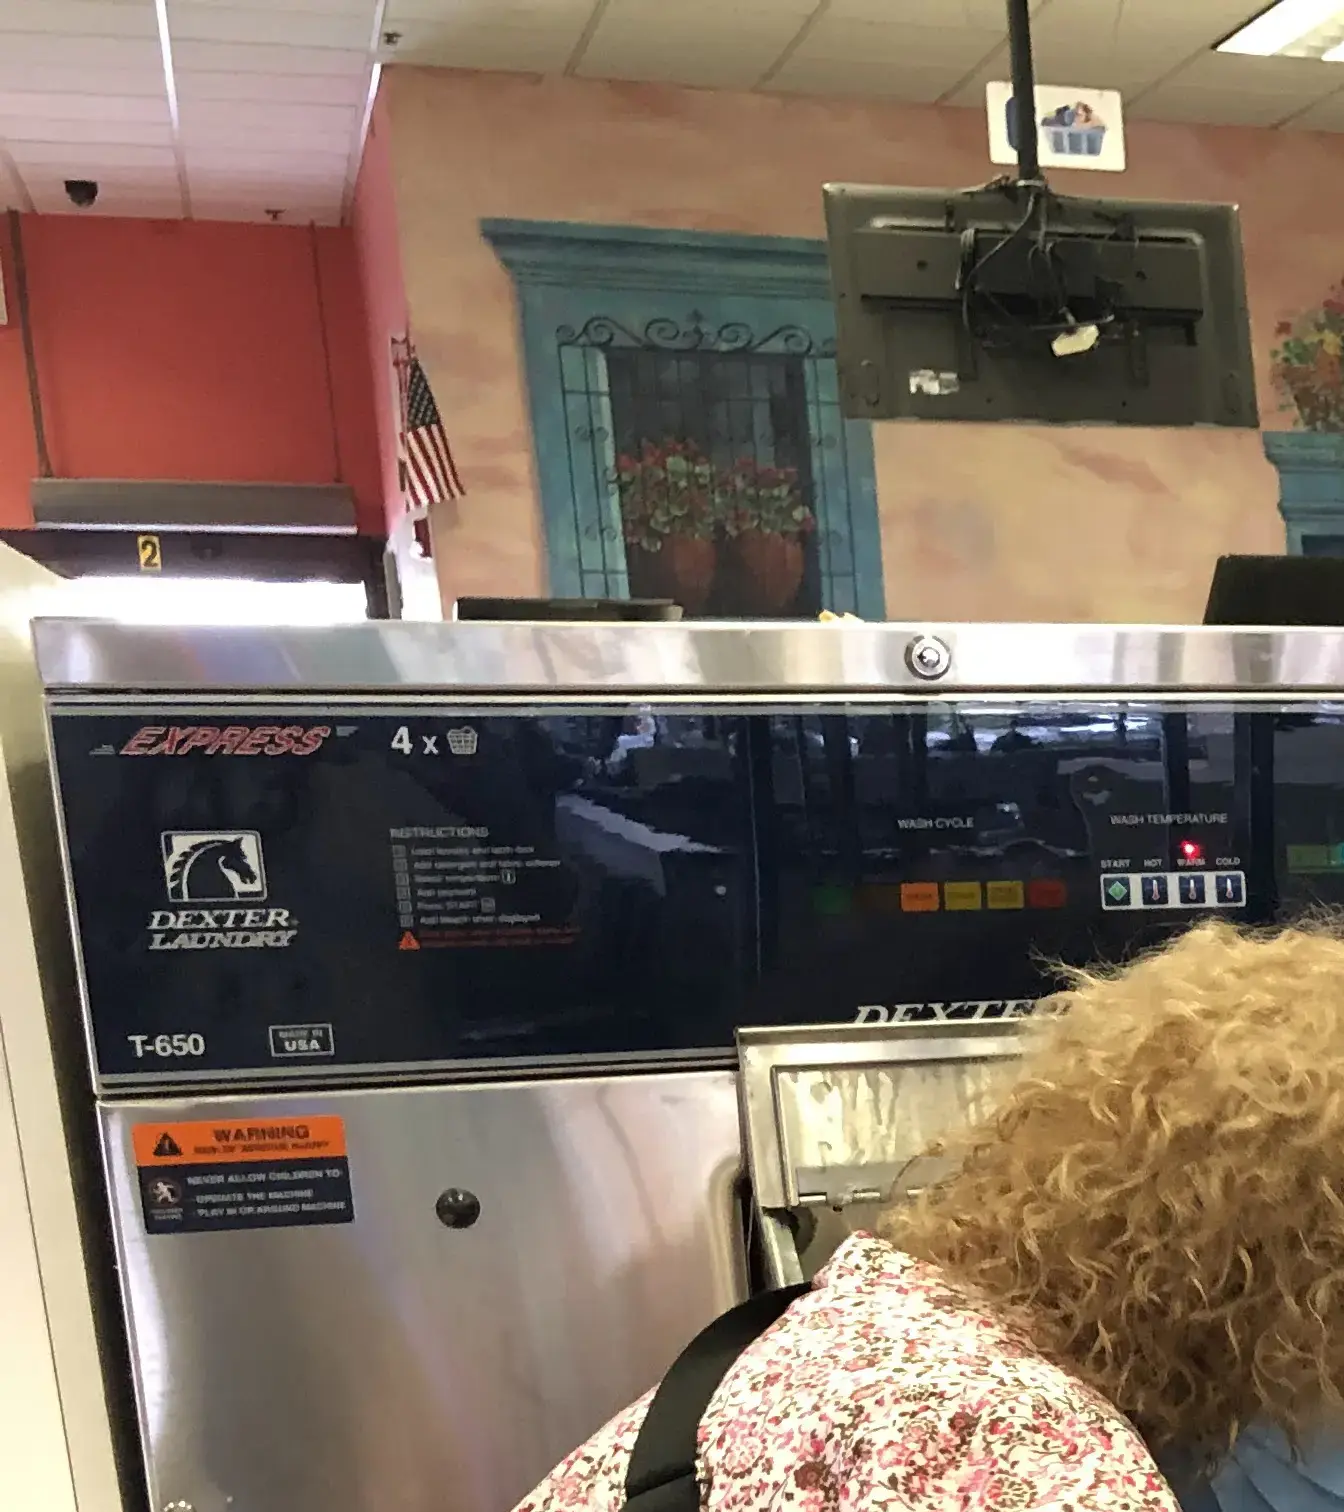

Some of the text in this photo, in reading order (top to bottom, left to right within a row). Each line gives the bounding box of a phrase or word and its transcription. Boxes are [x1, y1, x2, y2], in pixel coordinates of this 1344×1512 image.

[142, 540, 158, 568] 2
[119, 726, 331, 756] EXPRESS
[391, 726, 413, 754] 4
[897, 817, 974, 829] WASH CYCLE
[1147, 813, 1228, 824] TEMPERATURE
[147, 908, 291, 931] DEXTER
[149, 930, 298, 950] LAUNDRY
[128, 1033, 206, 1059] T-650
[284, 1039, 320, 1052] USA
[213, 1125, 309, 1143] WARNING
